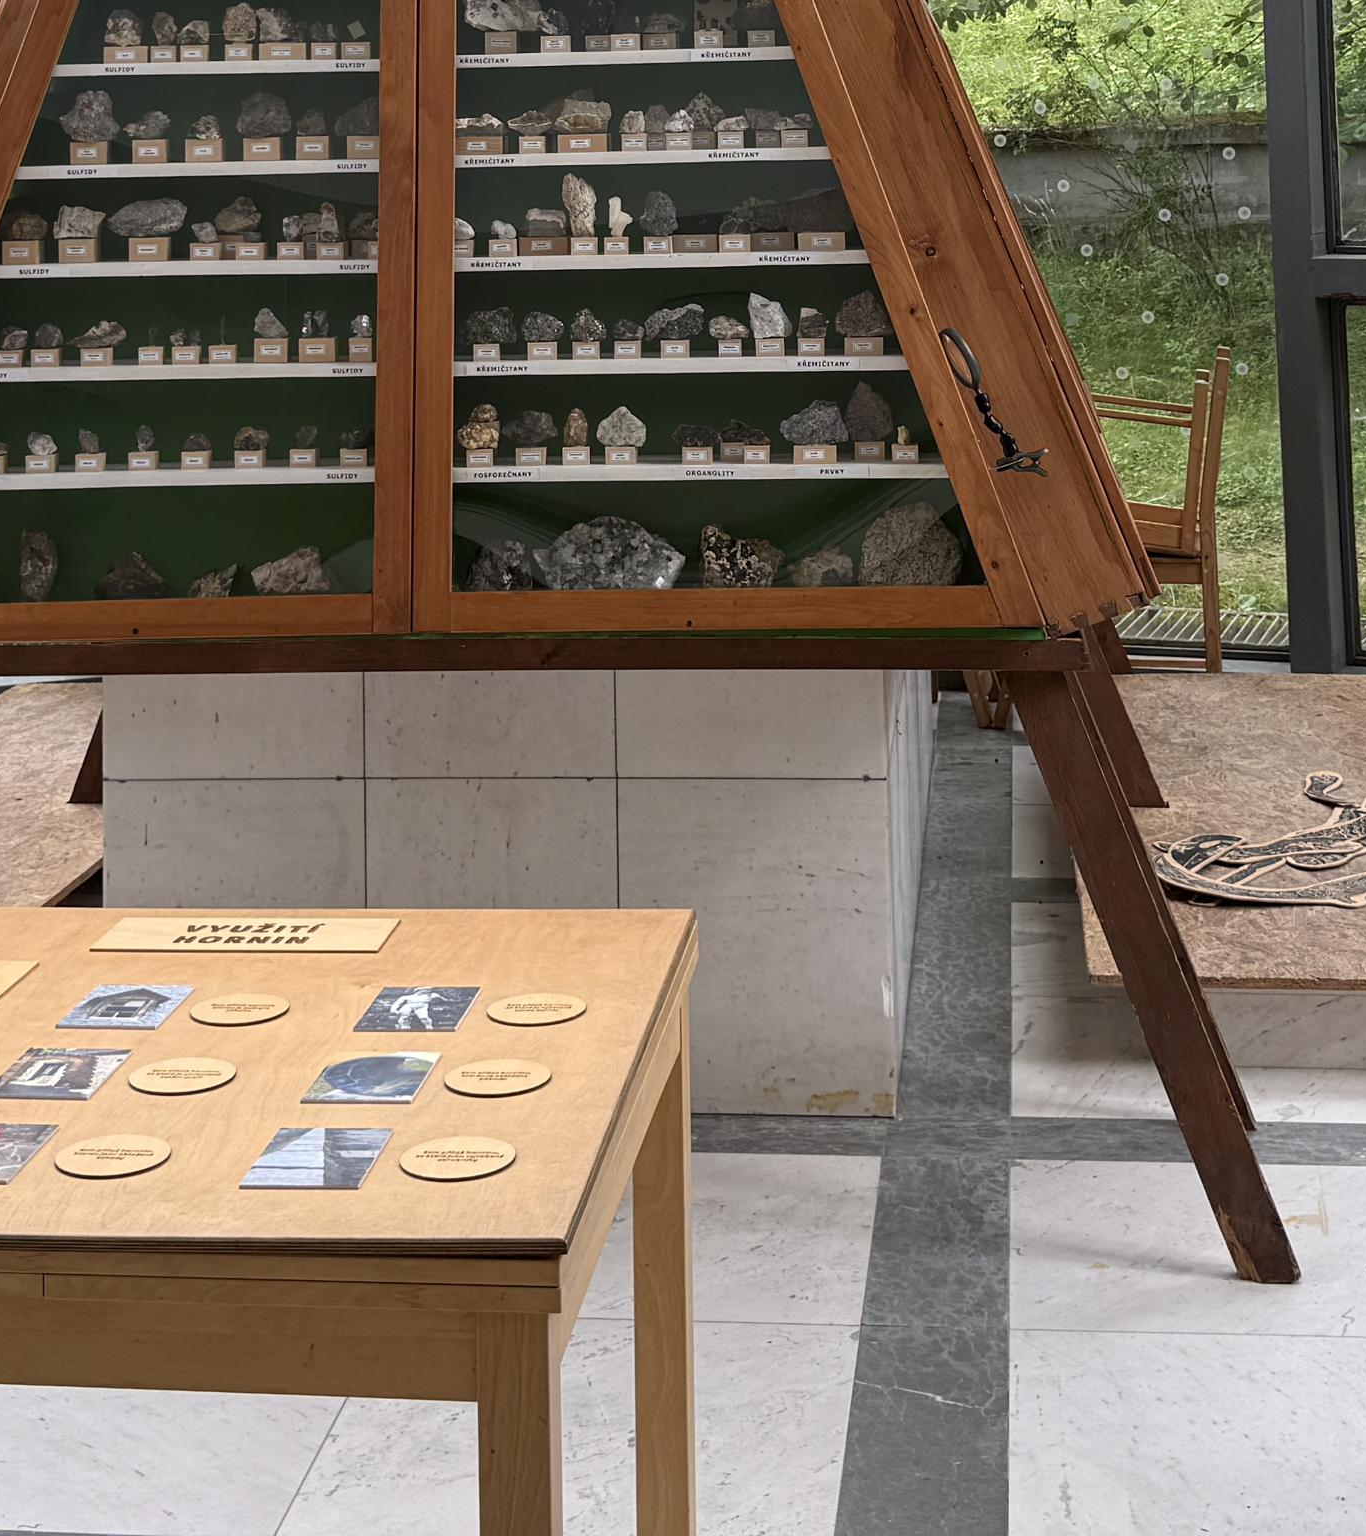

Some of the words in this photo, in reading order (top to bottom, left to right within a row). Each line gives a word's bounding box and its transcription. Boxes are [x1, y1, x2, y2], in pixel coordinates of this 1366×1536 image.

[700, 51, 751, 59] KŘEMIČITANY
[104, 65, 135, 73] SULFIDY
[708, 151, 759, 159] KŘEMIČITANY
[797, 359, 850, 368] KŘEMIČITANY
[476, 365, 528, 373] KŘEMIČITANY
[186, 922, 326, 934] VYUŽITÍ
[173, 934, 311, 945] HORNIN
